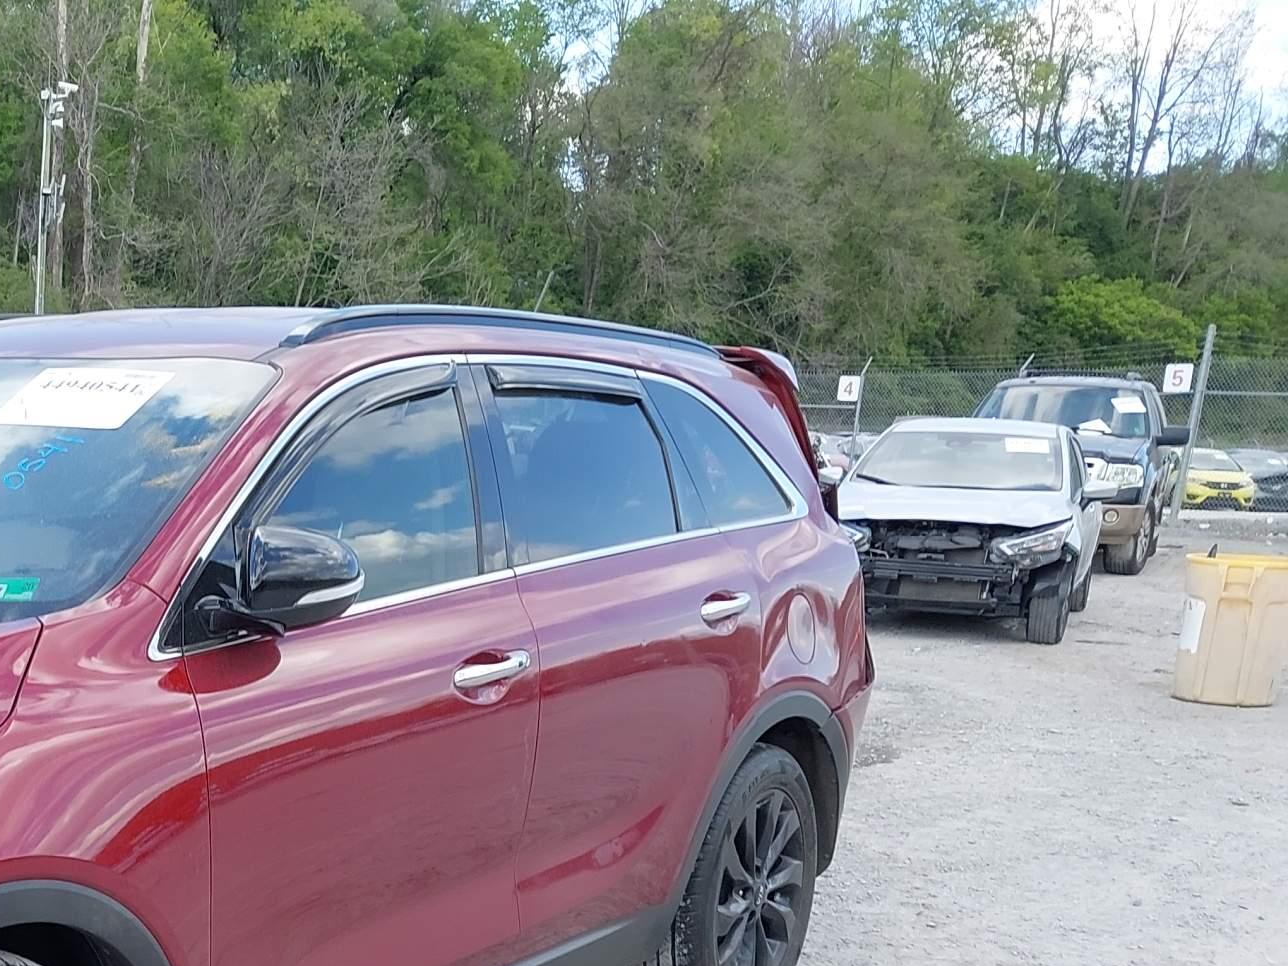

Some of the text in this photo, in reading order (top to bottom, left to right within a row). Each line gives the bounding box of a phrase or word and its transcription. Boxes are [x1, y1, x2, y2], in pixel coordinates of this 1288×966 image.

[1172, 369, 1184, 387] 5
[843, 381, 854, 396] 4
[3, 432, 86, 490] 0541
